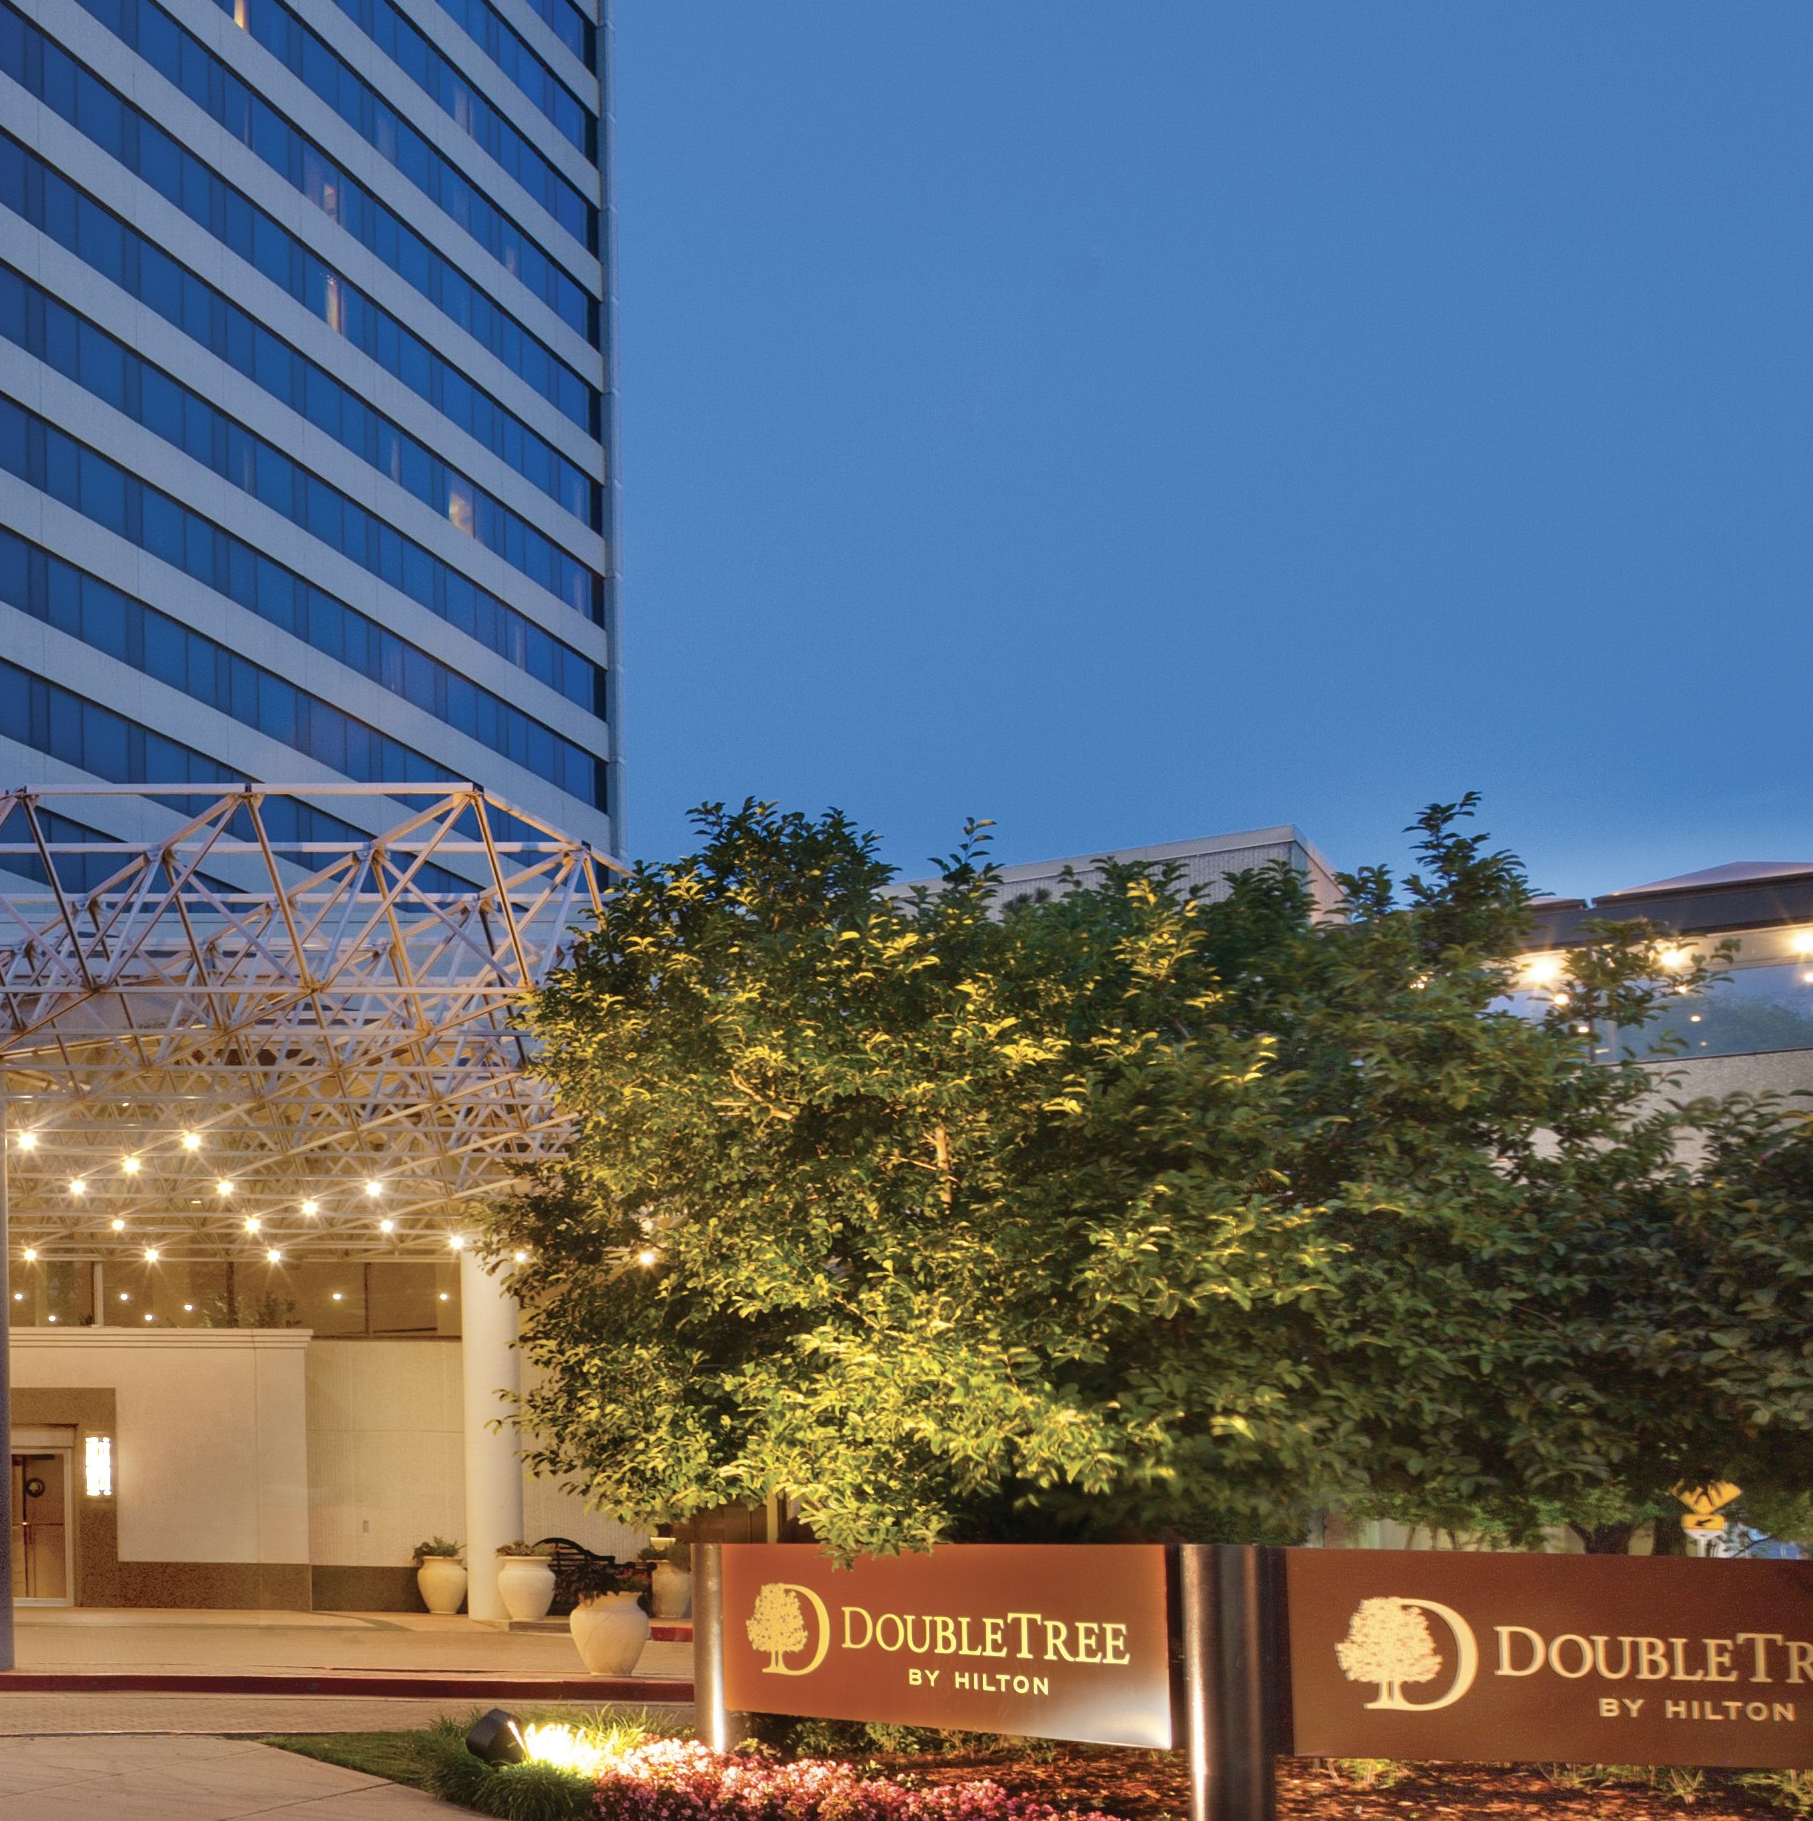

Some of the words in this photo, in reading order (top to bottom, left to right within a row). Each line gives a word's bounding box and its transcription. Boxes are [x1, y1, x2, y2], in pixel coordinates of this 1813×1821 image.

[840, 1606, 1132, 1666] DOUBLETREE
[908, 1668, 940, 1687] BY
[954, 1671, 1050, 1696] HILTON
[1598, 1697, 1645, 1718] BY
[1665, 1699, 1795, 1722] HILTON
